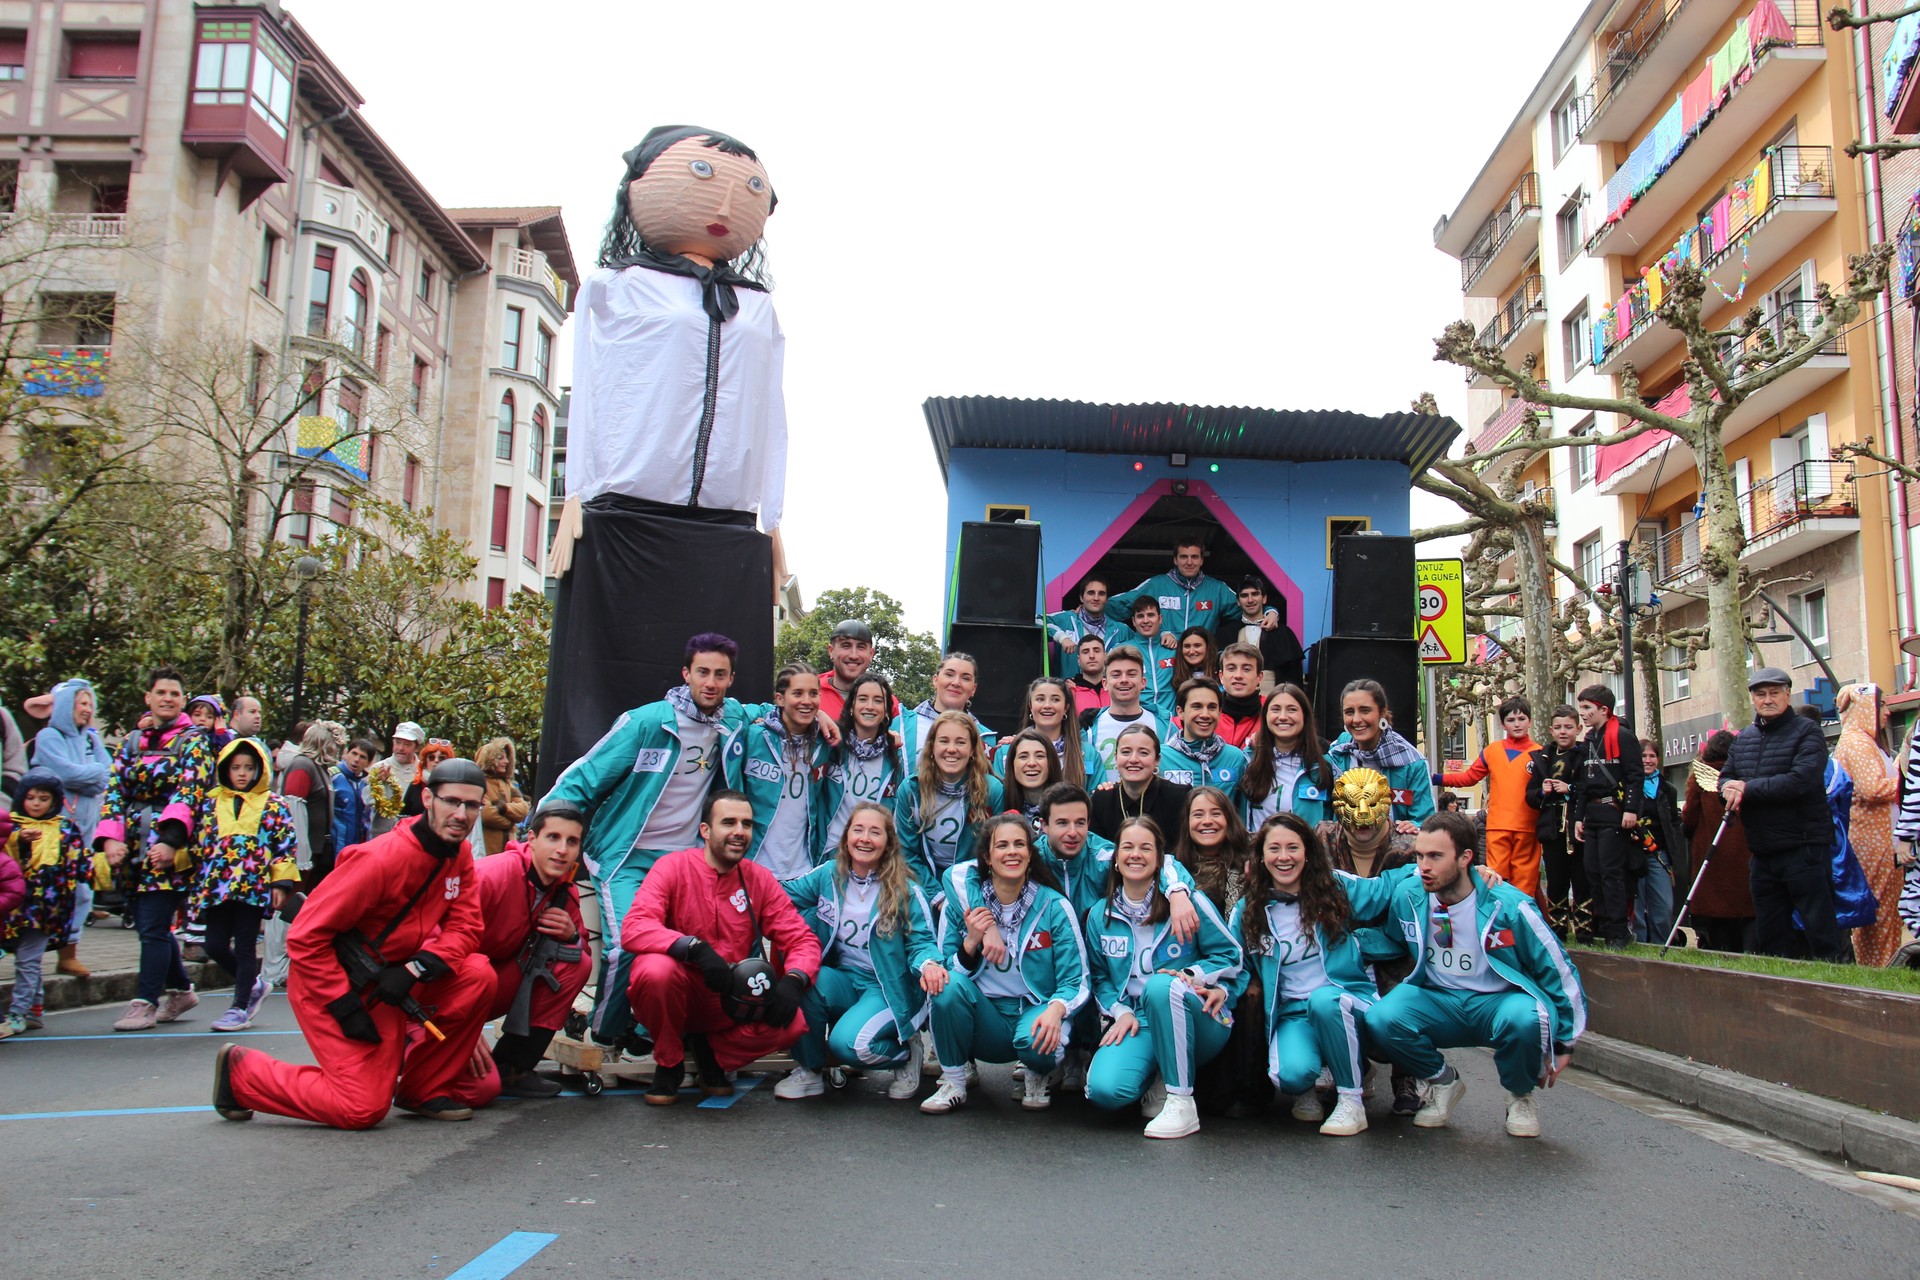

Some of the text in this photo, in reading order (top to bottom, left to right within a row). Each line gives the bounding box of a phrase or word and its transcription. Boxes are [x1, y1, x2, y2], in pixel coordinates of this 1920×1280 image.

[1416, 563, 1444, 571] ONTUZ
[1431, 572, 1460, 581] GUNEA
[1161, 597, 1177, 607] 211
[1419, 597, 1440, 609] 30
[749, 760, 780, 780] 205
[1166, 770, 1193, 785] 213
[1100, 938, 1126, 955] 204
[1426, 946, 1473, 971] 206
